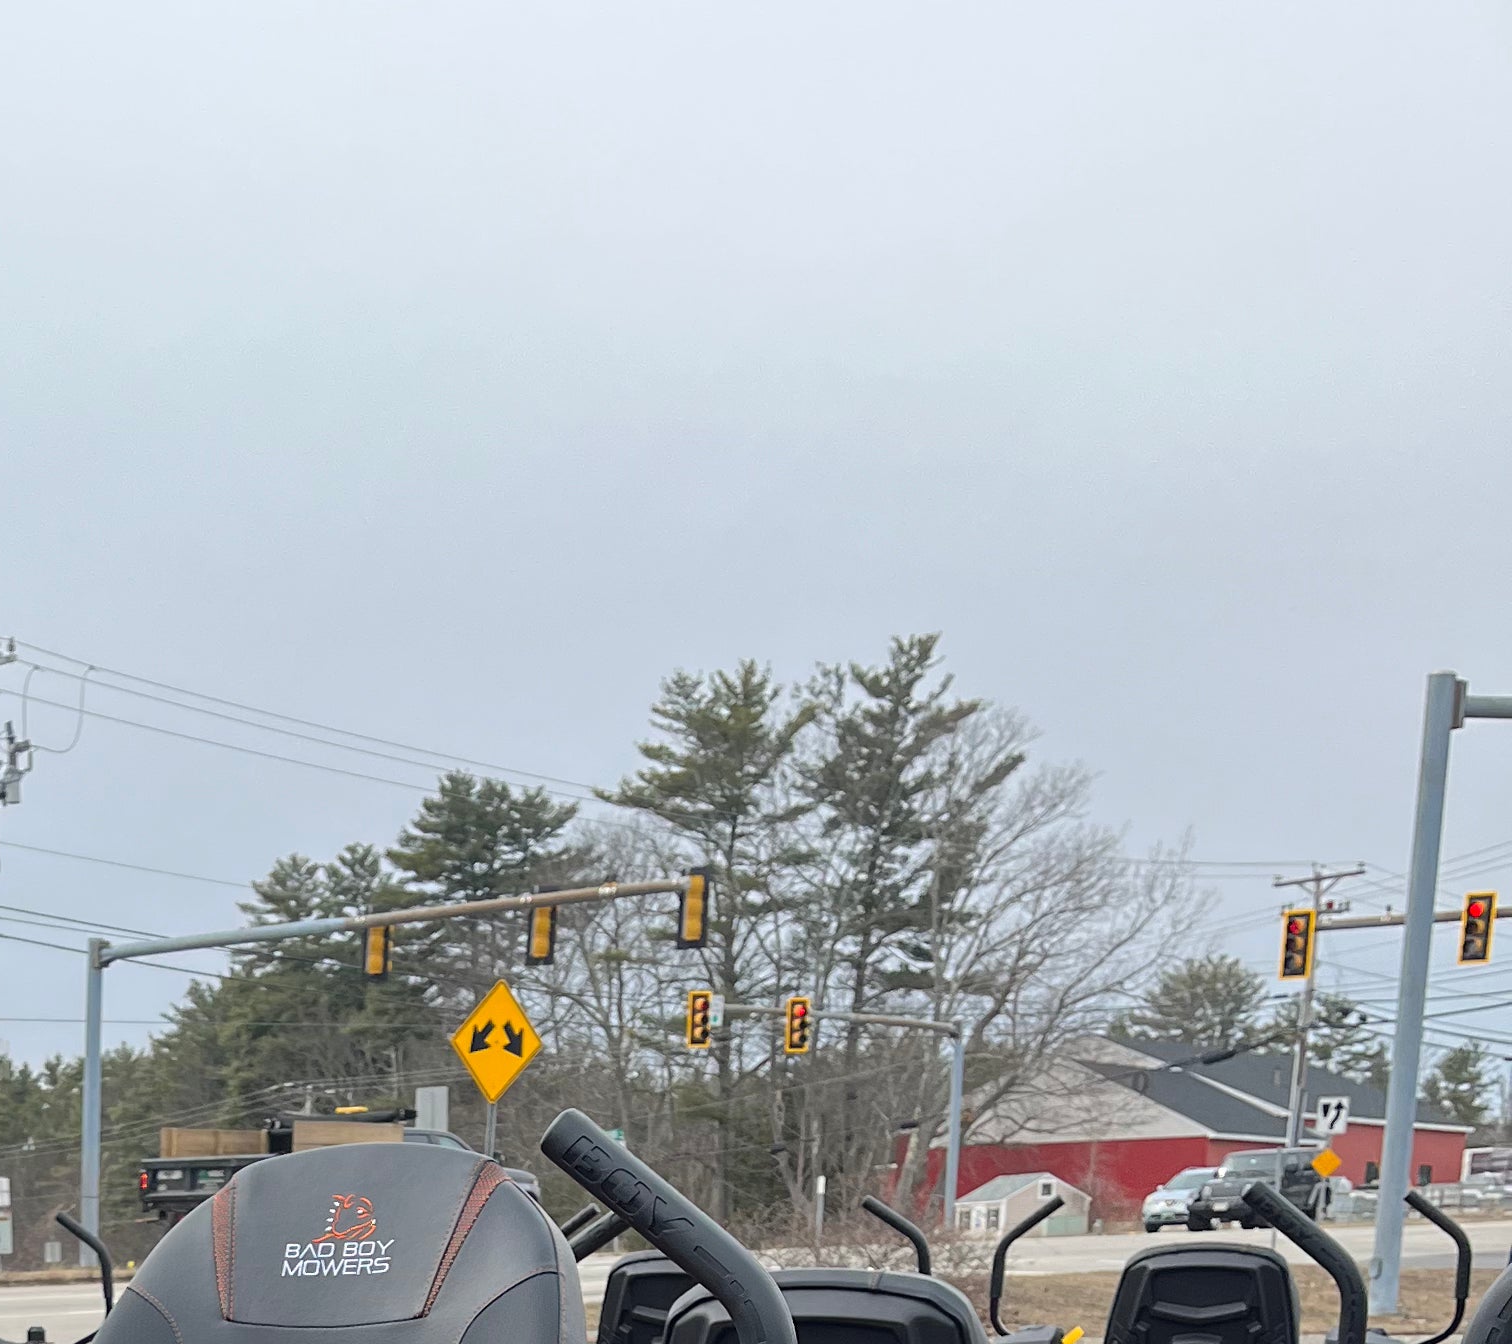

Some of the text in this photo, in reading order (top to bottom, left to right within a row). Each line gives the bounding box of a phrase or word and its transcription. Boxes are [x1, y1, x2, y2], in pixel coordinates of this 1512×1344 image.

[284, 1239, 395, 1259] BAD BOY
[280, 1256, 392, 1278] MOWERS
